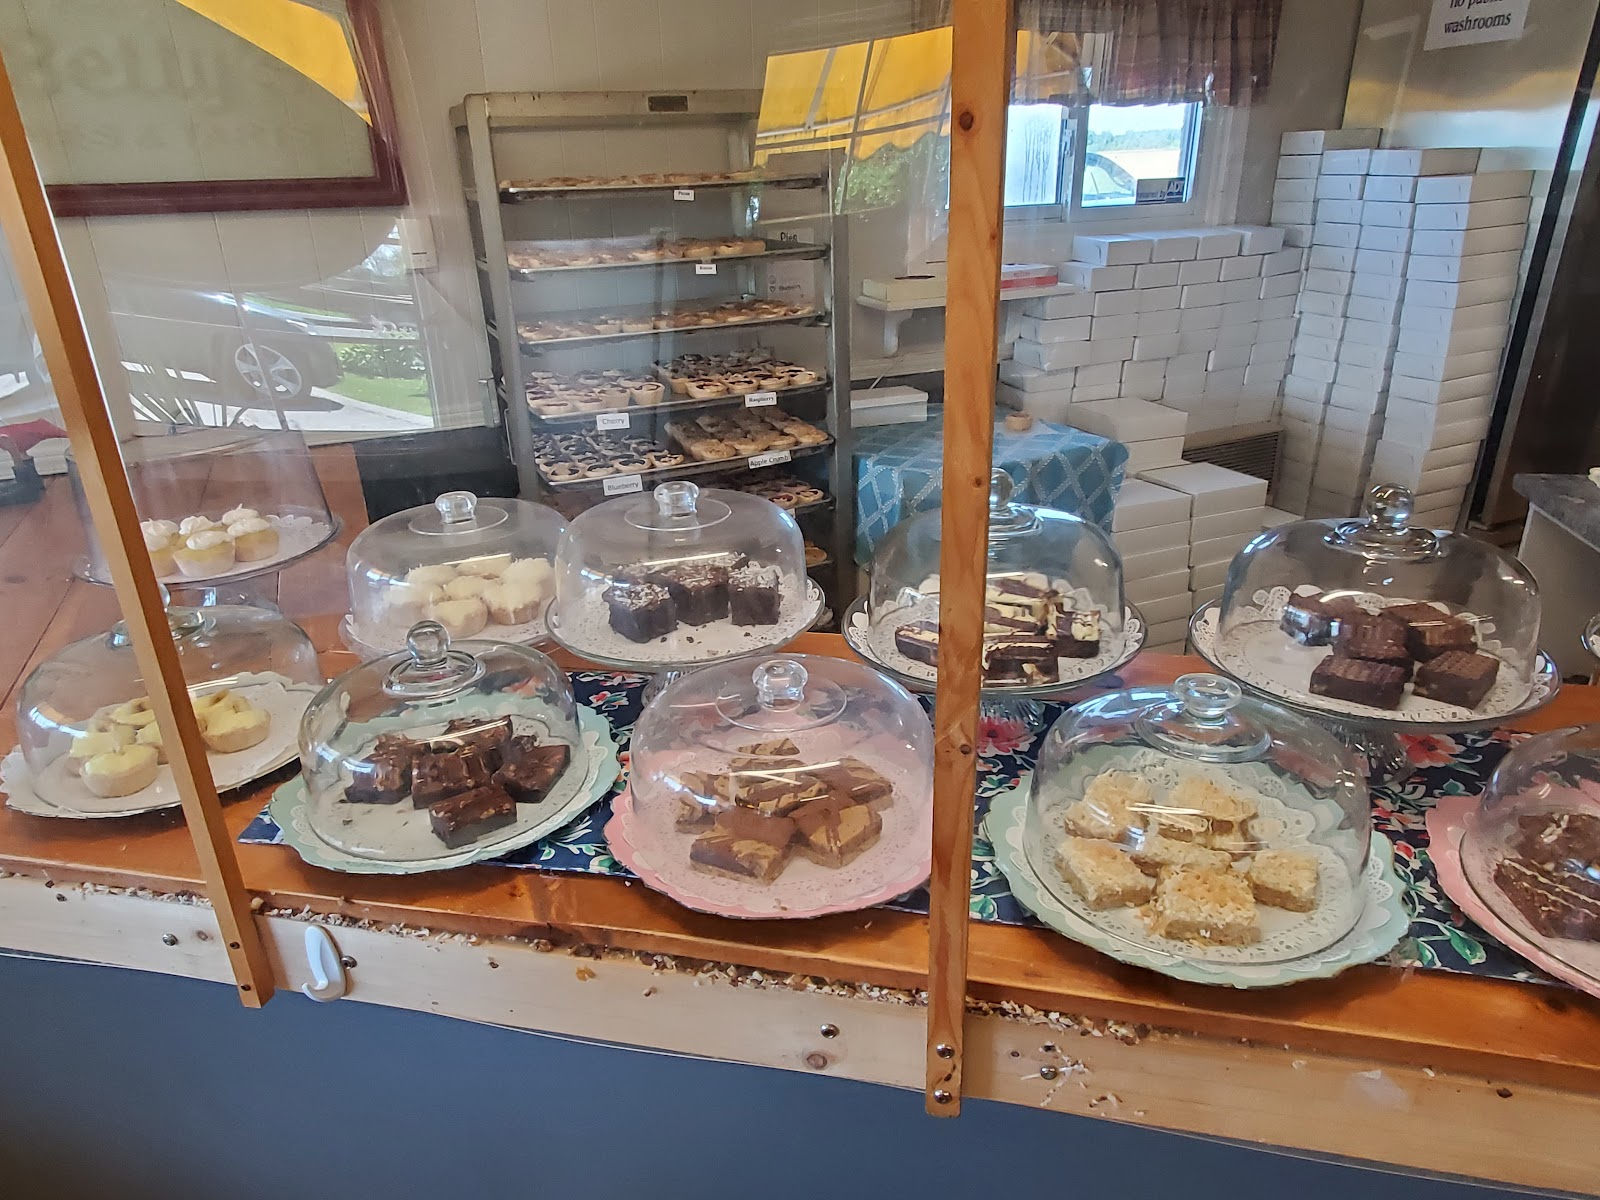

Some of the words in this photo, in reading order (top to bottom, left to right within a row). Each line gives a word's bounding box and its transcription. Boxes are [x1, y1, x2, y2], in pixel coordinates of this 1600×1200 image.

[1444, 13, 1512, 33] washrooms
[601, 417, 626, 426] Cherry
[750, 457, 768, 467] Apple
[769, 454, 790, 464] Crumb
[606, 481, 640, 492] Blueberry
